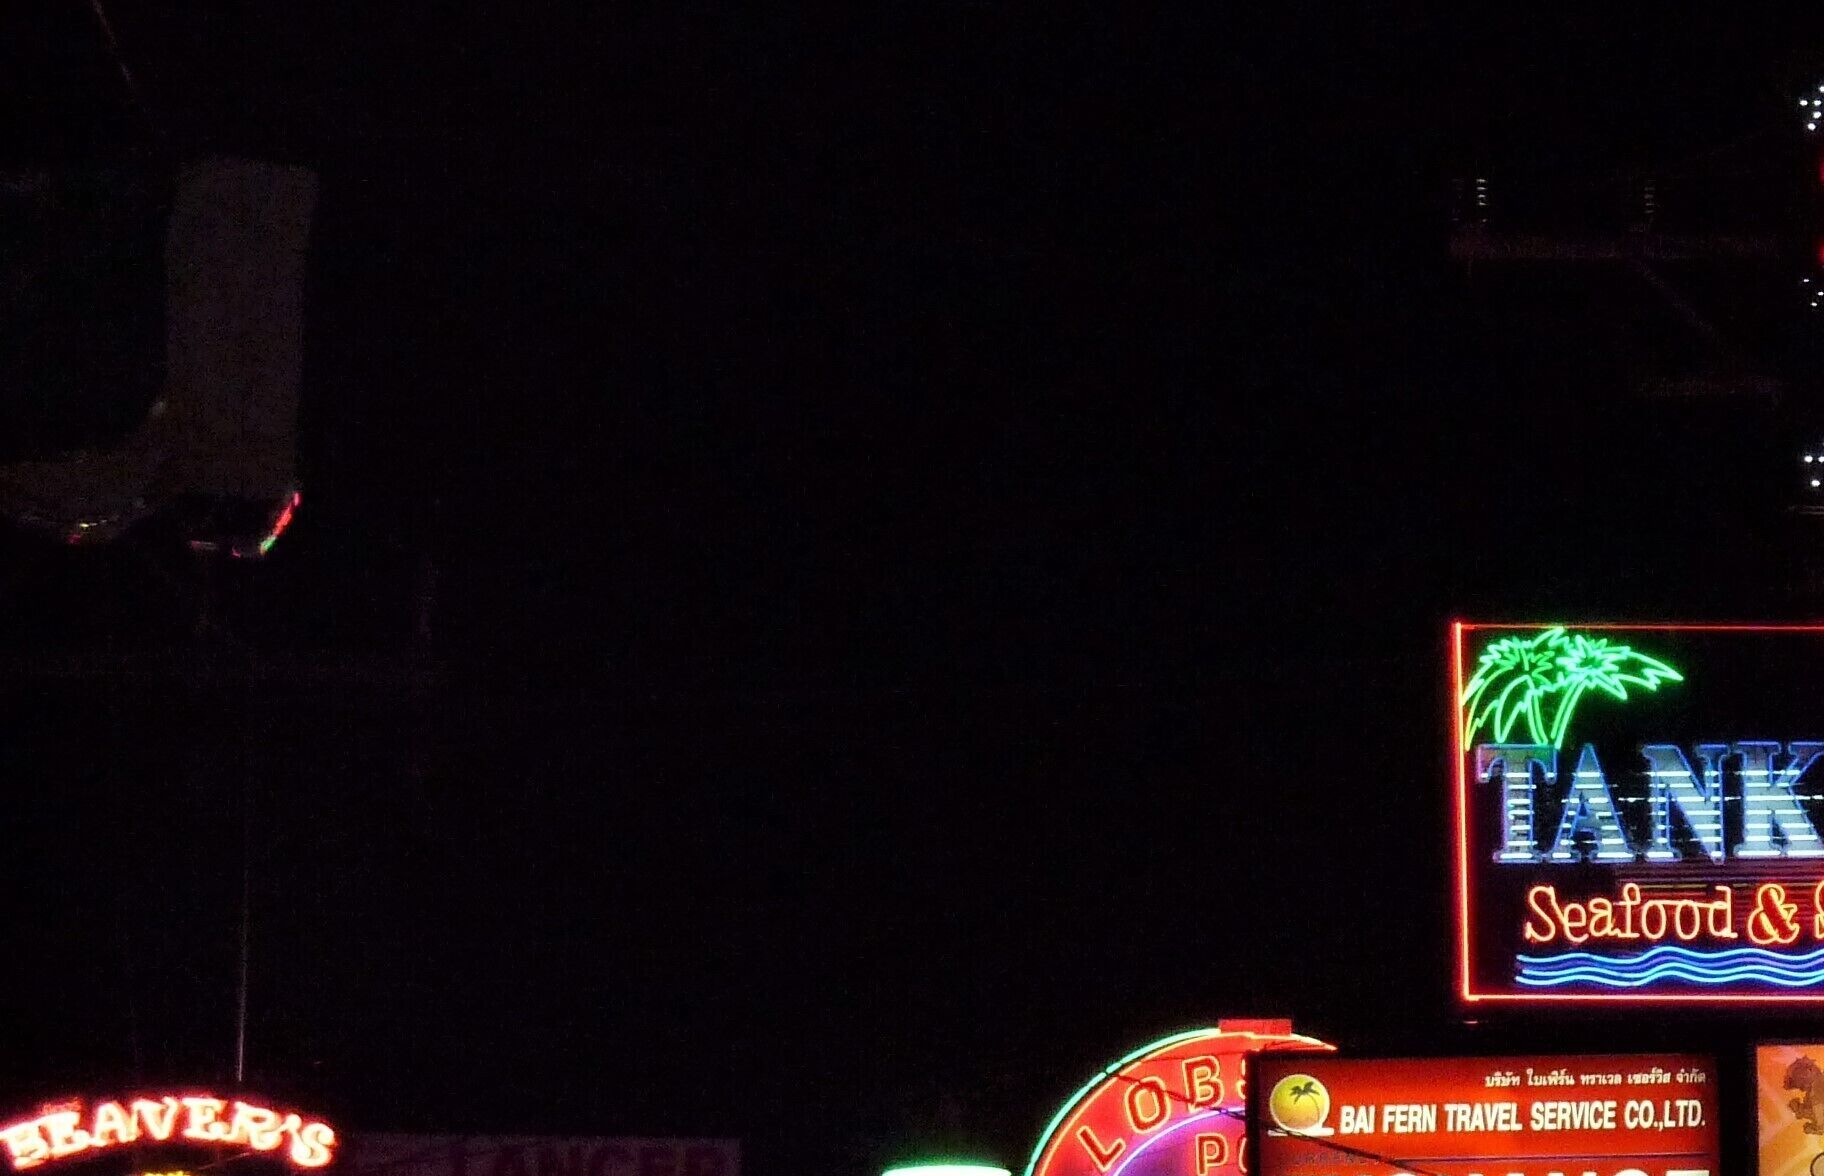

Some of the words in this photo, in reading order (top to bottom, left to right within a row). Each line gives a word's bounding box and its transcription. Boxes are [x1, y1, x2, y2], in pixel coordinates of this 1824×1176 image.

[1524, 883, 1738, 943] Seafood
[1747, 882, 1800, 945] &
[0, 1095, 338, 1170] BEAVER'S
[1077, 1054, 1247, 1175] LOB
[1339, 1104, 1376, 1135] BAI
[1383, 1102, 1437, 1134] FERN
[1445, 1101, 1523, 1132] TRAVEL
[1530, 1100, 1617, 1131] SERVICE
[1624, 1098, 1707, 1132] CO.,LTD.
